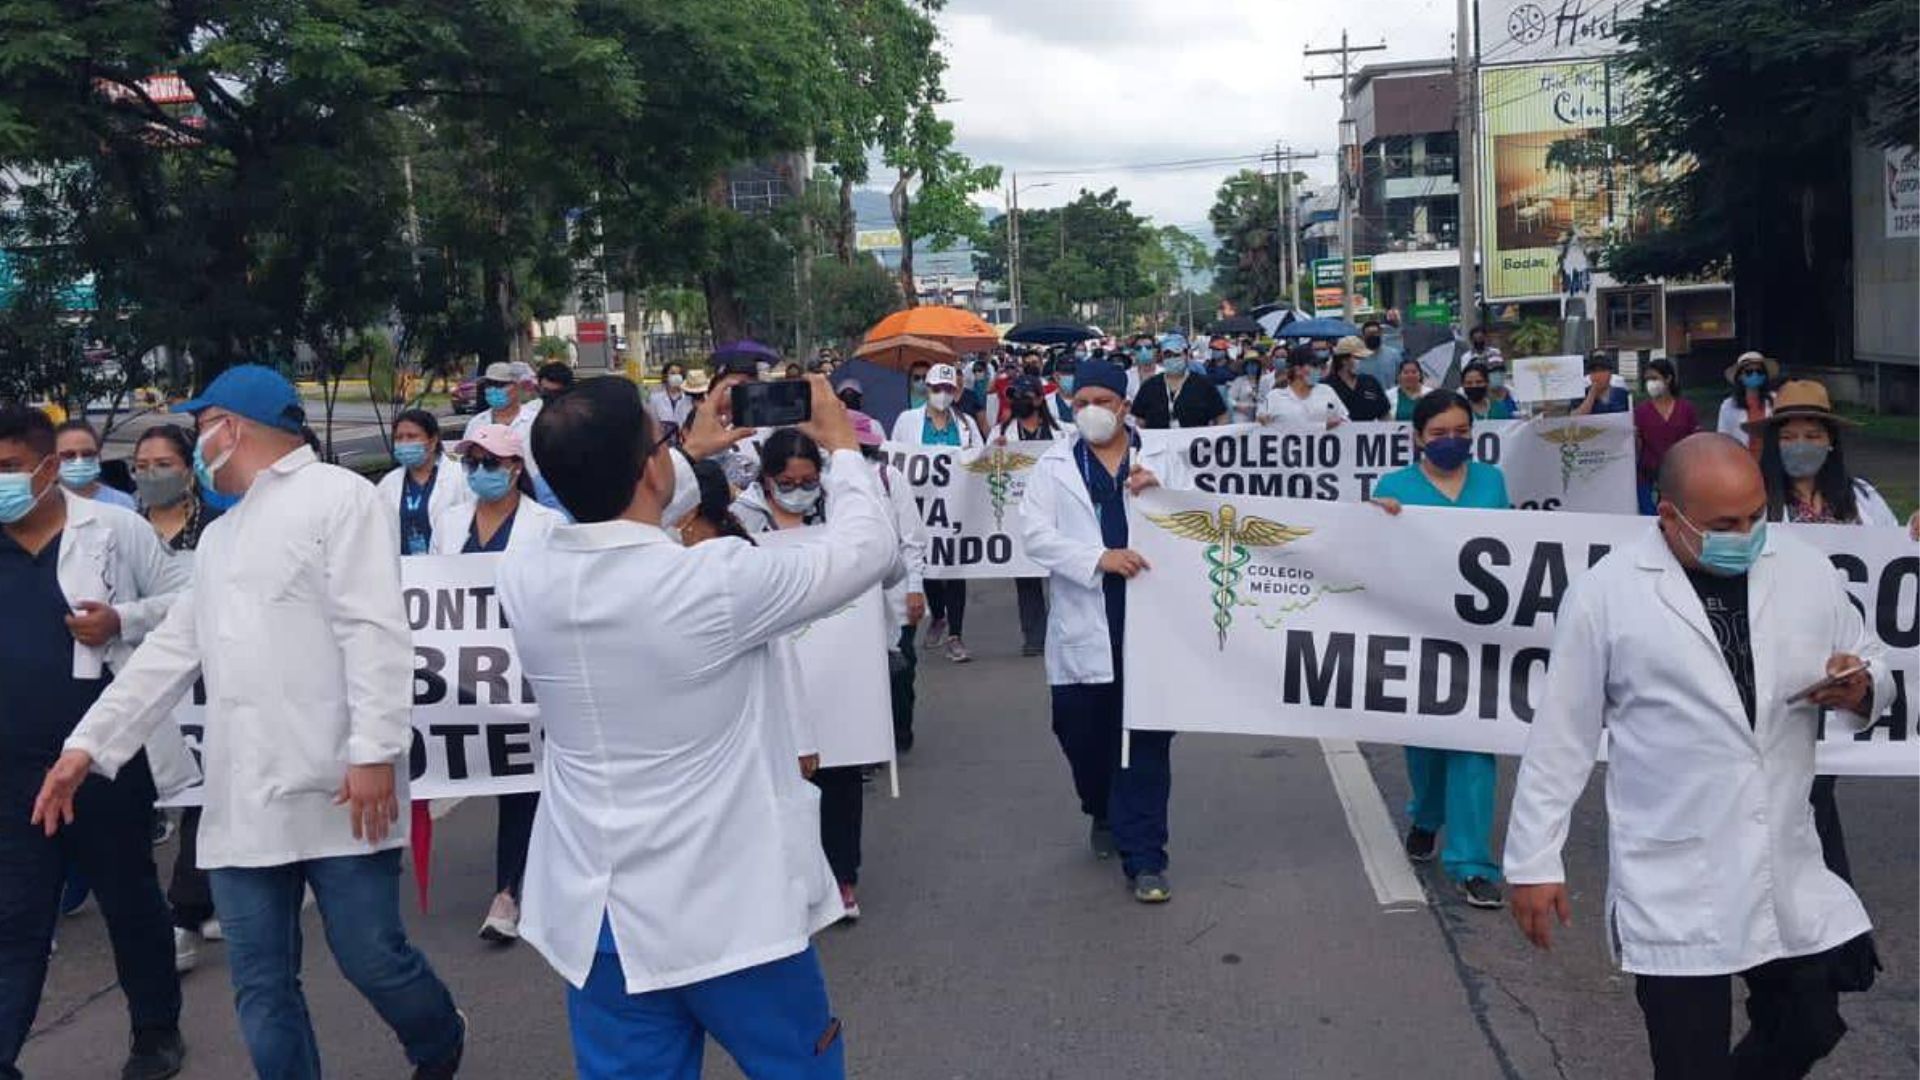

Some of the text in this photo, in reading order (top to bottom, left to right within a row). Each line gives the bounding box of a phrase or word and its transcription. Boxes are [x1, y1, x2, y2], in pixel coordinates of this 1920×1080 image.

[1554, 0, 1619, 47] Hotel
[1554, 92, 1626, 125] Colonal
[1189, 434, 1341, 468] COLEGIO
[1194, 472, 1340, 502] SOMOS
[922, 534, 1012, 567] NDO
[1247, 565, 1314, 580] COLEGIO
[1250, 580, 1311, 596] MÉDICO
[413, 646, 536, 706] BR
